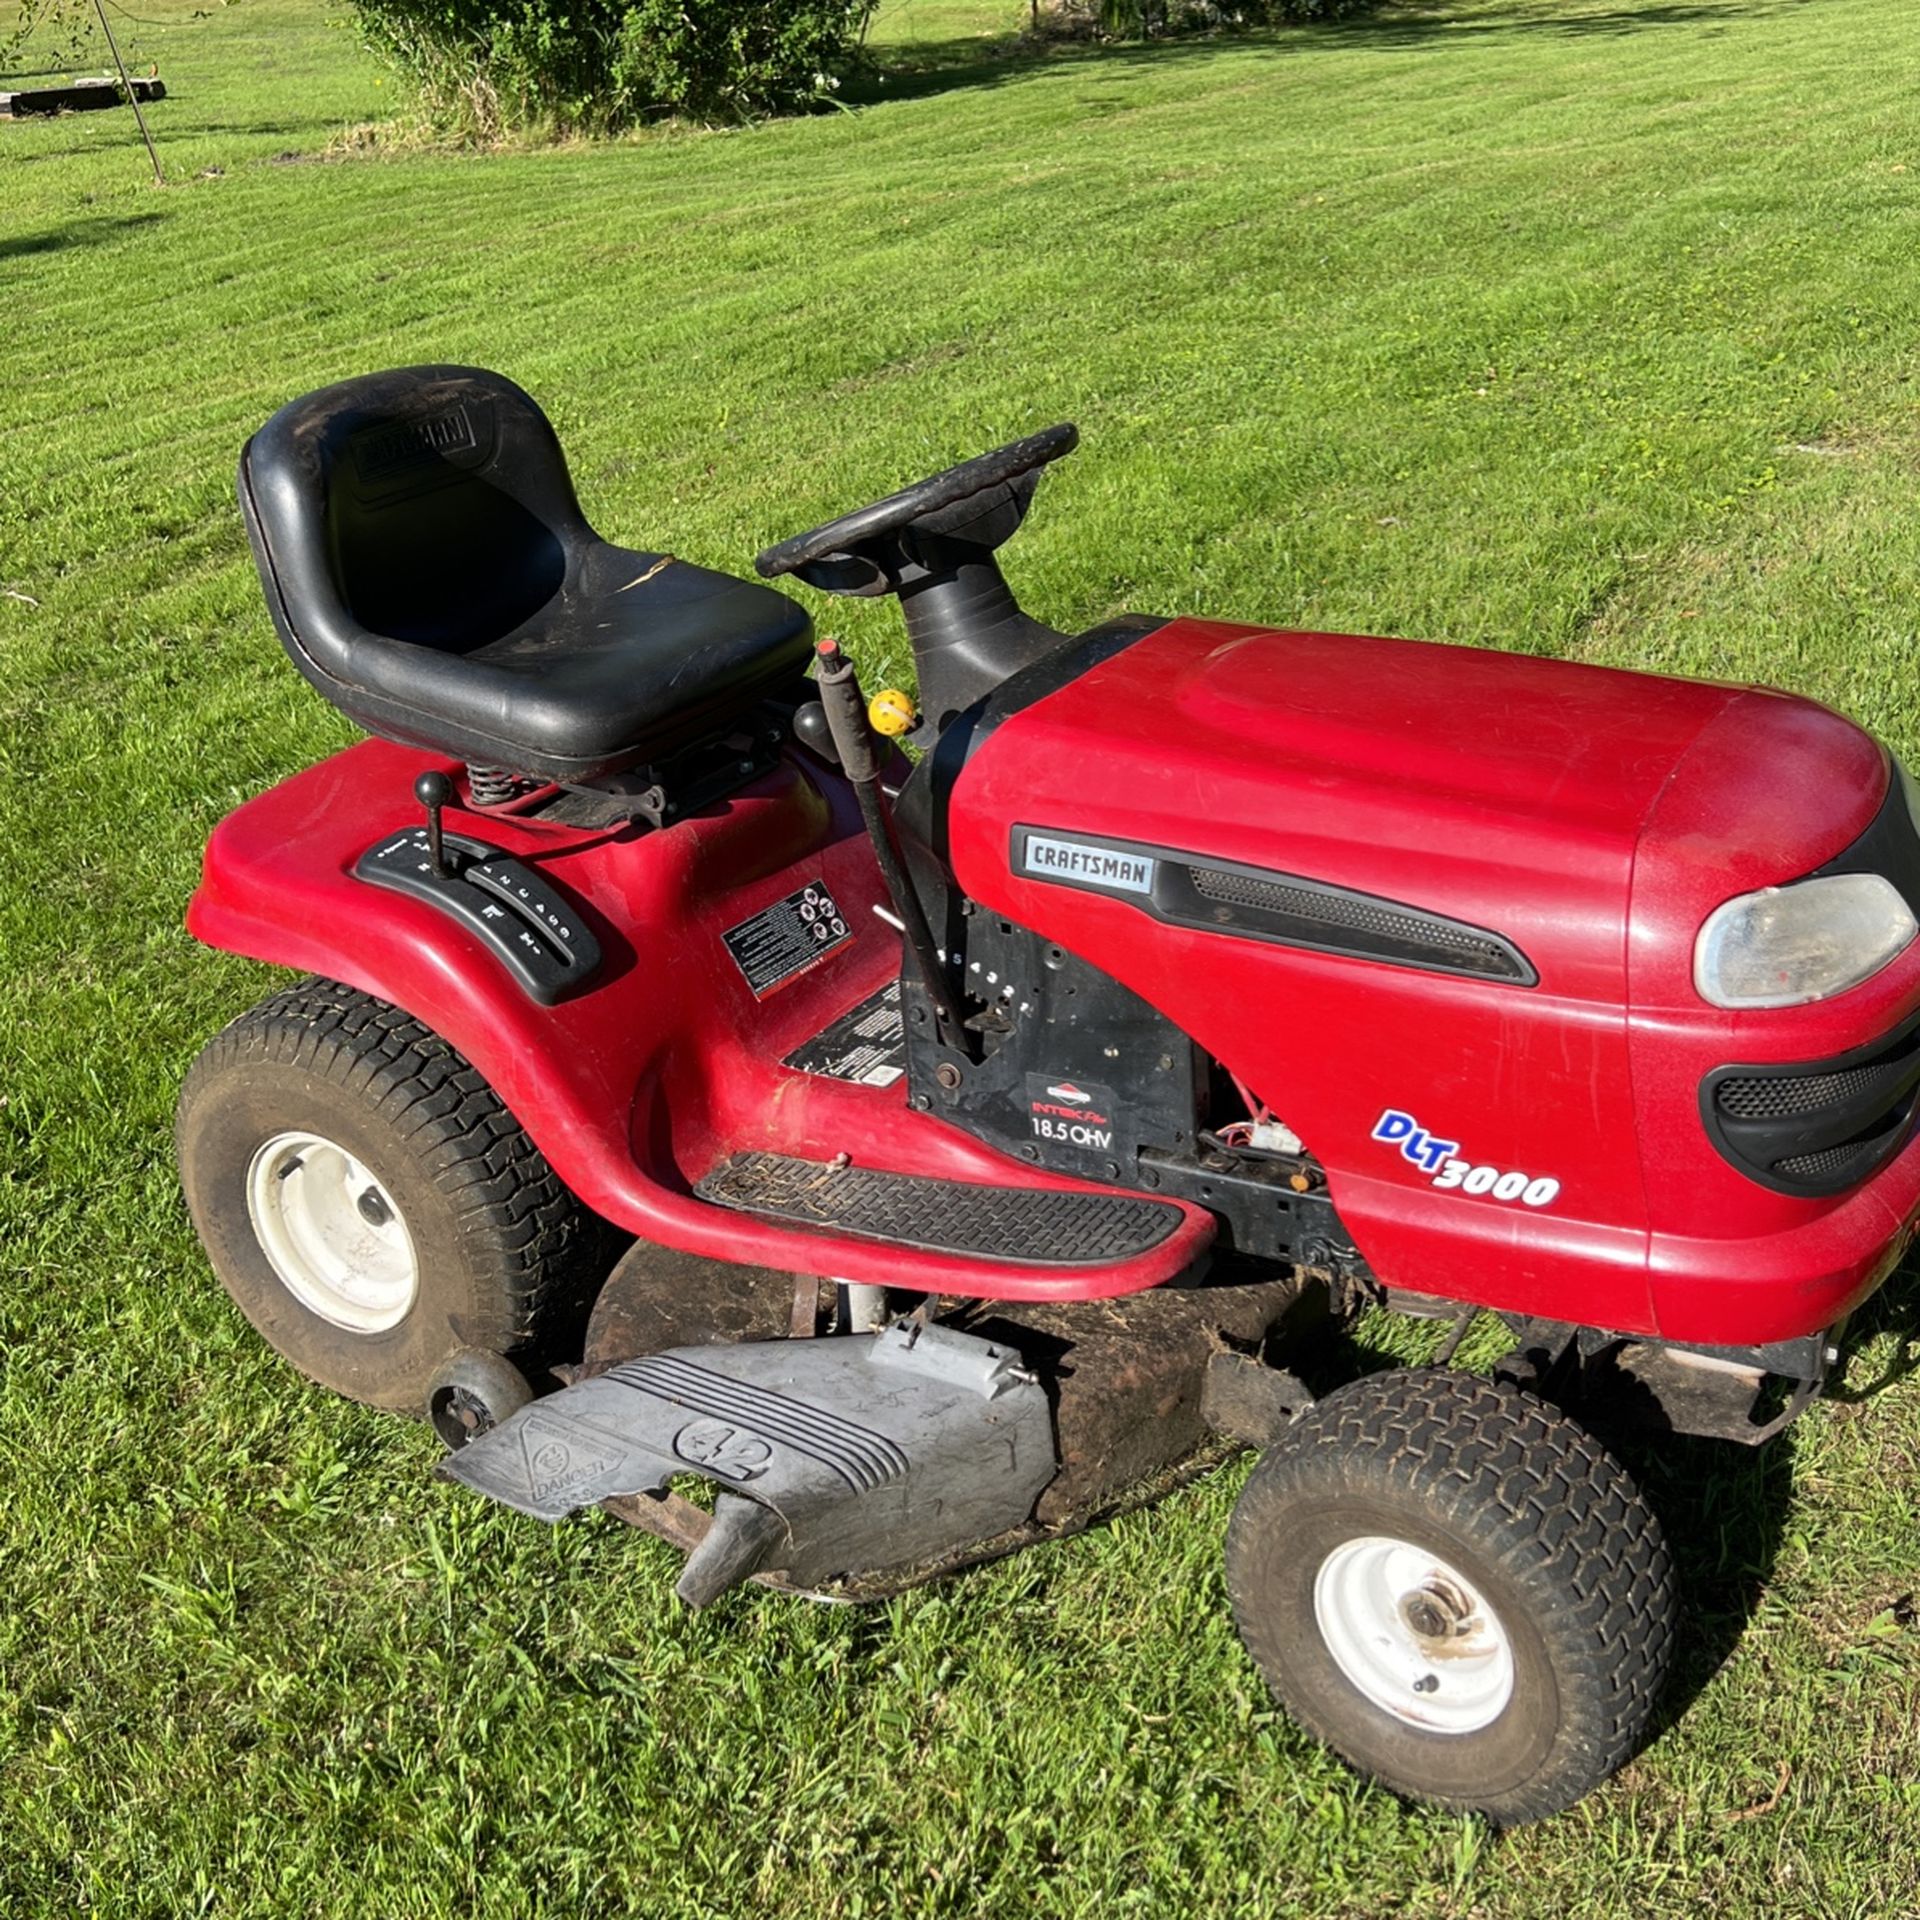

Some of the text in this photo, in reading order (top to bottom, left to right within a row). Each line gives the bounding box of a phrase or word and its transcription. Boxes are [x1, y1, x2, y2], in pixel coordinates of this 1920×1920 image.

[1034, 845, 1146, 884] CRAFTSMAN
[483, 865, 570, 939] 1 2 3 4 5 6
[986, 971, 998, 984] 3
[1002, 984, 1015, 998] 2
[1031, 1117, 1112, 1149] 18.5 OHV
[1432, 1159, 1560, 1206] 3000
[680, 1427, 773, 1481] 42
